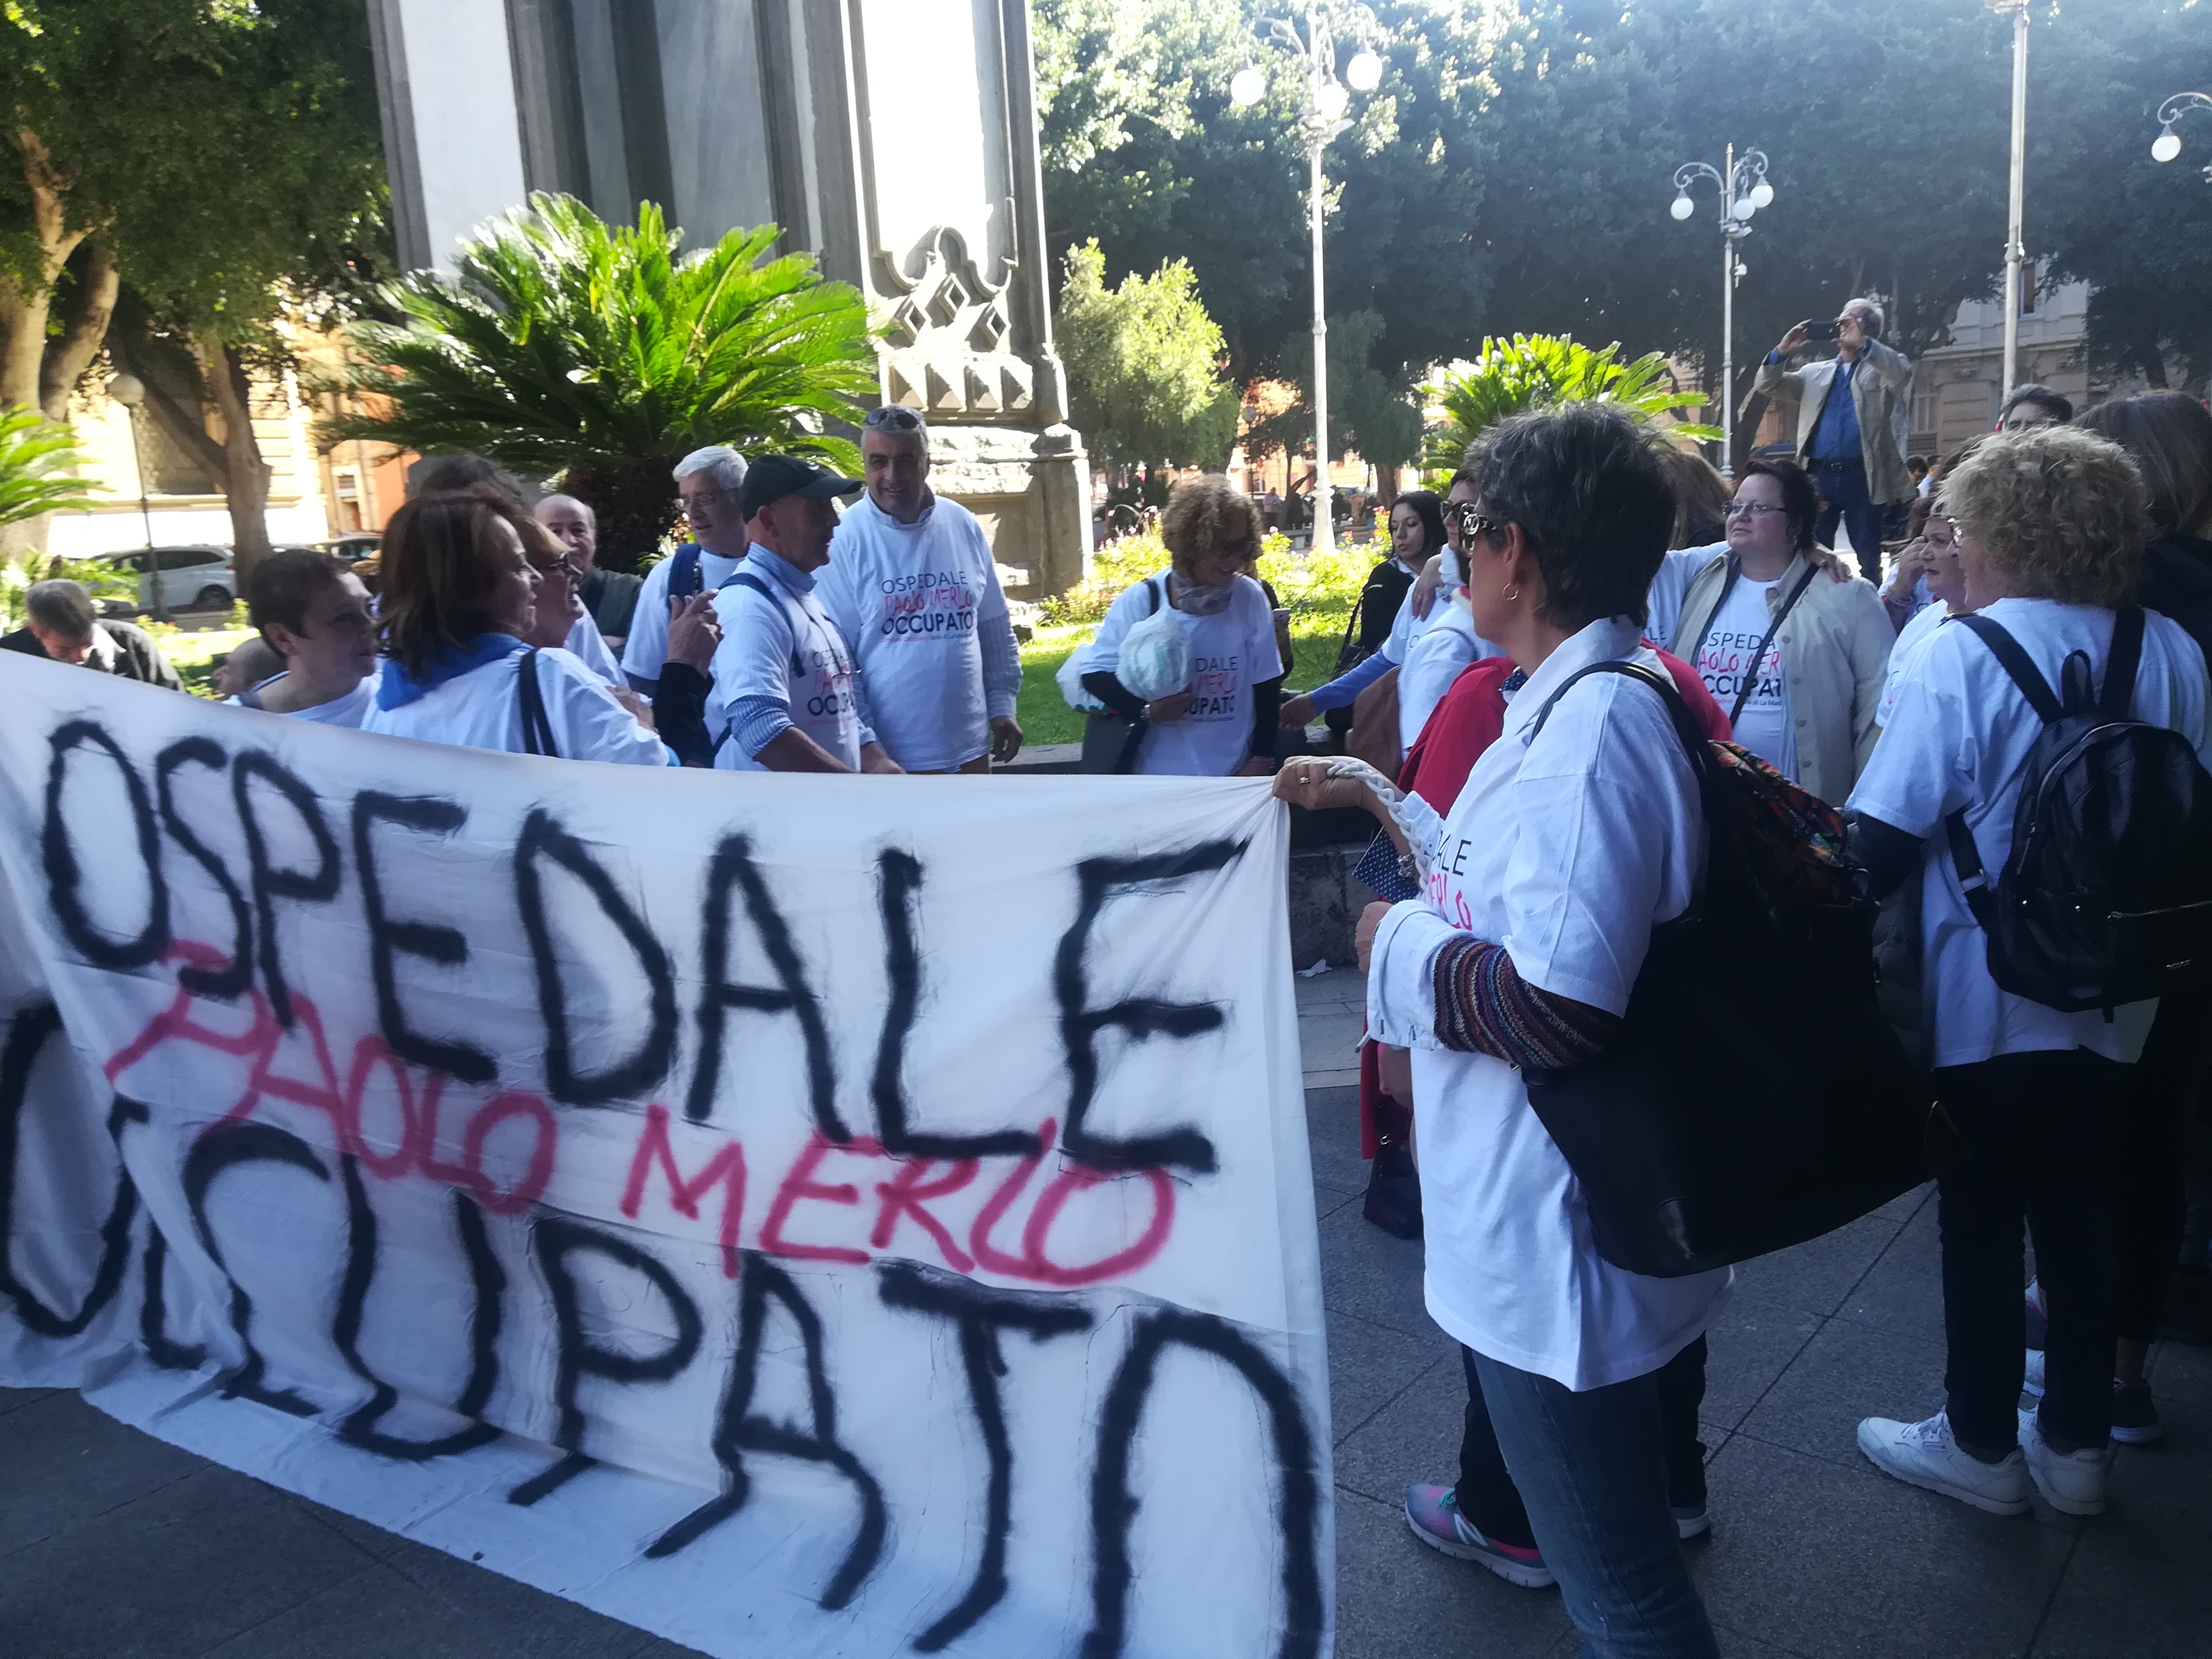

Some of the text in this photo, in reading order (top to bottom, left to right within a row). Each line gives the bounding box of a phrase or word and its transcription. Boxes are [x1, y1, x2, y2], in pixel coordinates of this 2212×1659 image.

[881, 570, 968, 594] OSPEDALE
[885, 585, 972, 617] PAOLO MERLO
[881, 611, 973, 635] OCCUPATO
[42, 720, 1248, 1172] OSPEDALE
[103, 939, 1176, 1286] PAOLO MERLO
